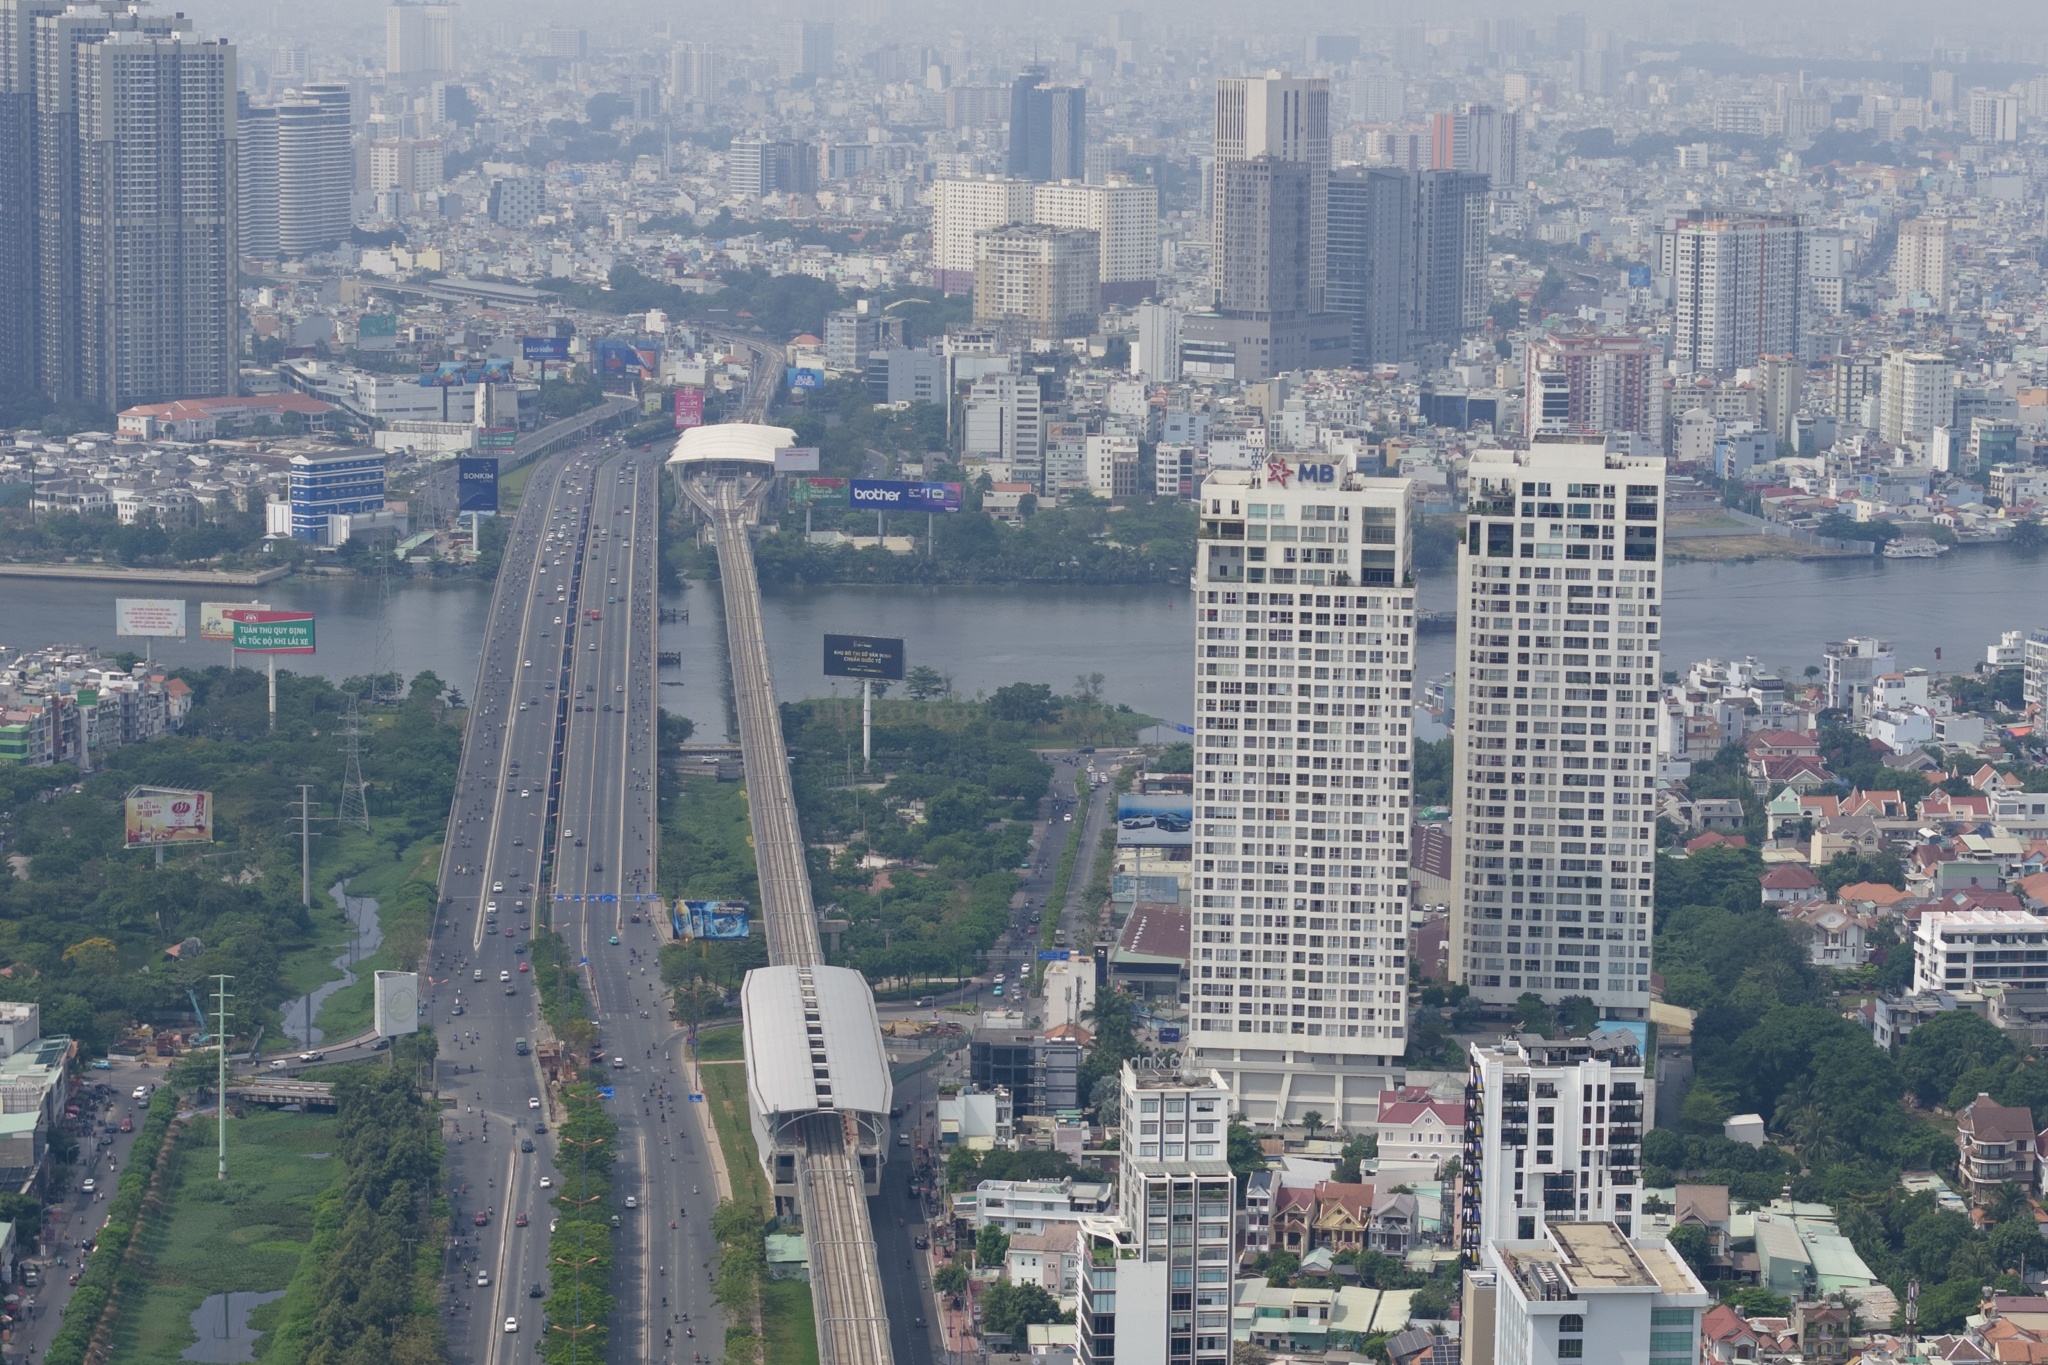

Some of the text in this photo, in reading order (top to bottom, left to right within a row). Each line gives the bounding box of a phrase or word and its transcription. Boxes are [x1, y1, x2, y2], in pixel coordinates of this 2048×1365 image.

[1297, 463, 1334, 483] MB
[854, 488, 901, 501] brother
[240, 624, 307, 636] TUÂN THỦ QUY ĐỊNH
[238, 636, 247, 644] VỀ
[248, 636, 262, 645] TỐC
[262, 636, 272, 646] ĐỘ
[288, 636, 299, 645] LÁI
